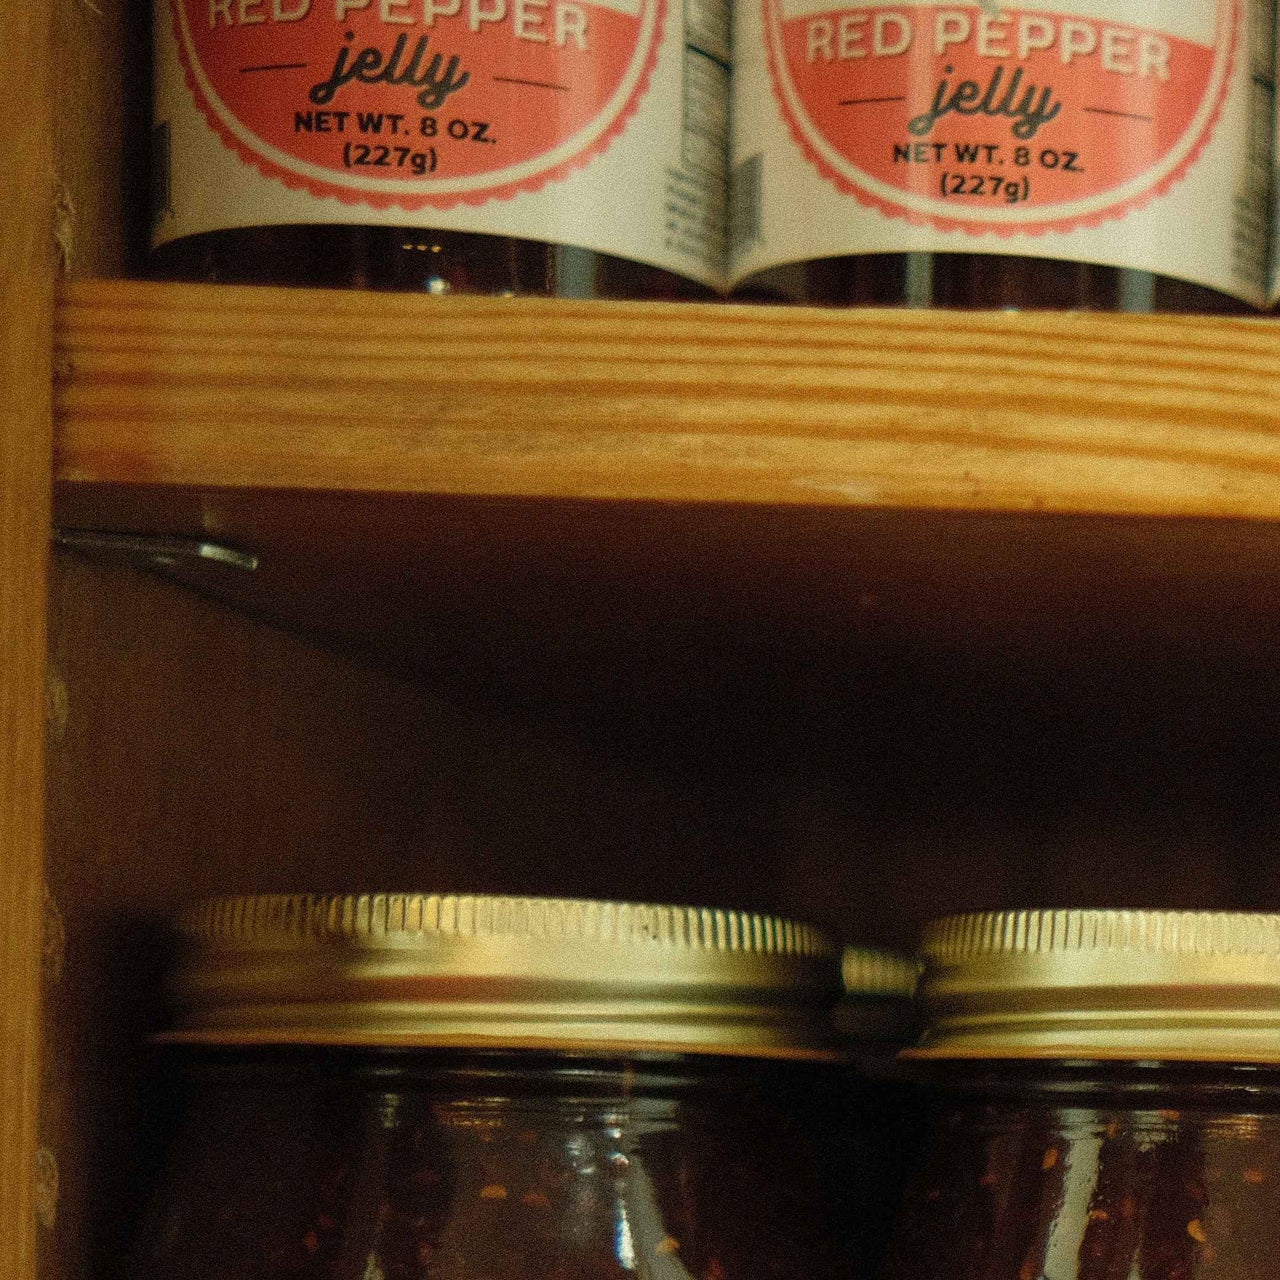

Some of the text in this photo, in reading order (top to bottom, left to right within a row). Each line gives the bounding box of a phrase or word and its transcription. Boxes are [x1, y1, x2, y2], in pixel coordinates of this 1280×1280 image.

[806, 13, 1171, 79] RED PEPPER
[310, 32, 470, 109] jelly
[908, 66, 1061, 139] jelly
[295, 111, 497, 144] NET WT. 8 OZ.
[343, 144, 438, 174] (227g)
[893, 143, 946, 164] NET
[955, 144, 1004, 166] WT.
[1014, 147, 1031, 167] 8
[940, 174, 1030, 203] (227g)
